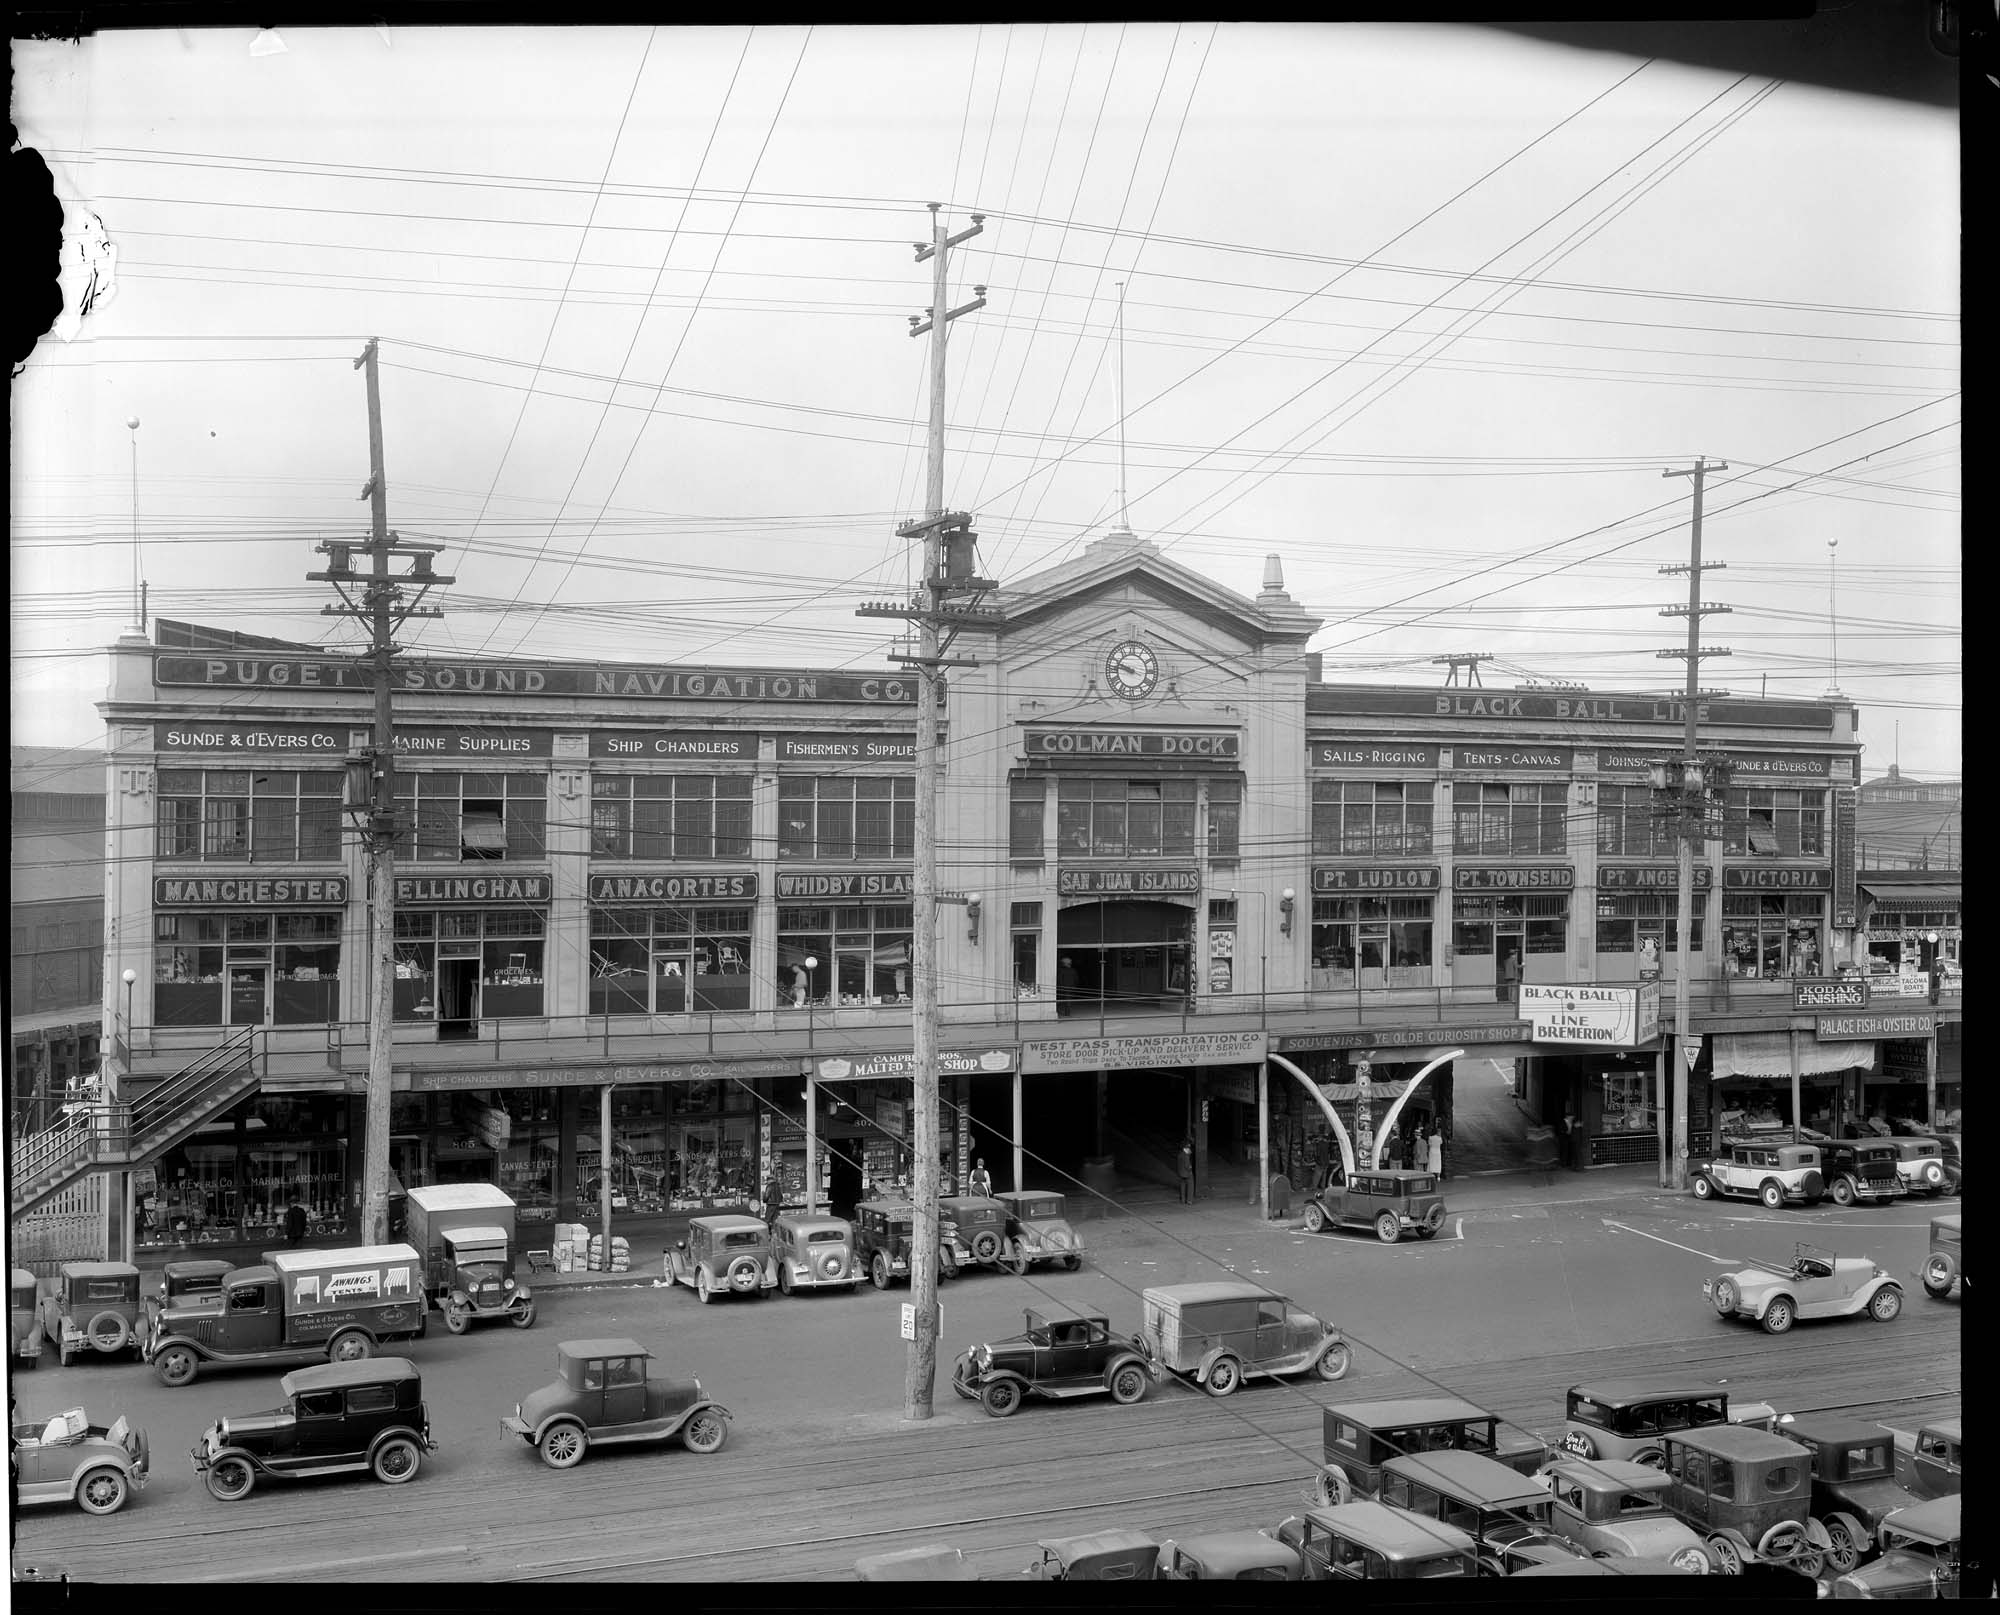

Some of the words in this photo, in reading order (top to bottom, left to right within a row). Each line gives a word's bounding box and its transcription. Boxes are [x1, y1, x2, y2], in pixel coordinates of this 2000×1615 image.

[205, 660, 350, 686] PUGET
[405, 669, 546, 692] SOUND
[595, 672, 818, 699] NAVIGATION
[861, 679, 911, 701] CO.
[1436, 697, 1522, 715] BLACK
[1556, 701, 1622, 719] BALL
[167, 731, 225, 746] SUNDE
[230, 733, 243, 747] &
[247, 732, 307, 748] d'EVERS
[391, 735, 446, 750] MARINE
[460, 736, 531, 751] SUPPLIES
[608, 738, 643, 753] SHIP
[655, 739, 740, 754] CHANDLERS
[1042, 735, 1142, 754] COLMAN
[1162, 737, 1225, 754] DOCK
[786, 741, 859, 756] FISHERMEN'S
[867, 743, 917, 756] SUPPLIE
[1463, 752, 1501, 764] TENTS
[1512, 754, 1561, 765] CANVAS
[1605, 755, 1649, 767] JOHNSO
[1736, 761, 1760, 770] UNDE
[1763, 761, 1770, 771] &
[1773, 761, 1806, 772] d'EVERS
[779, 876, 855, 895] WHIDBY
[860, 875, 914, 894] ISLAN
[1062, 871, 1092, 891] SAN
[1098, 872, 1132, 891] JUAN
[1138, 872, 1198, 891] ISLANDS
[1323, 871, 1347, 888] PT.
[1357, 870, 1433, 887] LUDLOW
[1458, 870, 1482, 887] PT.
[1486, 870, 1571, 887] TOWNSEND
[1606, 870, 1627, 886] PT.
[1635, 870, 1706, 886] ANGES
[1740, 869, 1819, 887] VICTORIA
[165, 880, 342, 901] MANCHESTER
[398, 879, 540, 899] ELLINGHAM
[600, 877, 745, 898] ANACORTES
[1902, 977, 1928, 985] TACOMA
[1525, 987, 1575, 1000] BLACK
[1580, 989, 1616, 1001] BALL
[1803, 986, 1857, 994] KODAK
[1798, 993, 1862, 1005] FINISHING
[1551, 1014, 1590, 1026] LINE
[1820, 1019, 1854, 1034] PALACE
[1856, 1019, 1876, 1033] FISH
[1876, 1021, 1883, 1031] &
[1883, 1017, 1916, 1032] OYSTER
[1918, 1016, 1932, 1031] CO.
[1289, 1036, 1363, 1049] SOUVENIRS
[1375, 1032, 1391, 1044] YE
[1393, 1031, 1424, 1043] OLDE
[1427, 1029, 1488, 1042] CURIOSITY
[1488, 1028, 1518, 1040] SHOP
[1538, 1026, 1613, 1041] BREMERTON
[1030, 1041, 1067, 1051] WEST
[1072, 1040, 1110, 1050] PASS
[1116, 1034, 1238, 1048] TRANSPORTATION
[1242, 1033, 1261, 1042] CO.
[873, 1054, 914, 1063] CAMPB
[937, 1052, 962, 1060] ROS.
[1040, 1050, 1072, 1059] STORE
[1075, 1049, 1099, 1058] DOOR
[1102, 1047, 1140, 1057] PICK-UP
[1142, 1046, 1163, 1054] AND
[1166, 1044, 1211, 1053] DELIVERY
[1216, 1042, 1253, 1051] SERVICE
[855, 1062, 904, 1076] MALTED
[944, 1059, 978, 1071] SHOP
[1126, 1059, 1182, 1067] VIRGINIA
[526, 1071, 586, 1083] SUNDE
[594, 1071, 607, 1081] &
[452, 1140, 475, 1149] 805
[136, 1180, 166, 1192] SUDE
[330, 1275, 374, 1287] AWNINGS
[330, 1287, 363, 1295] TENTS
[1566, 1432, 1579, 1444] Give
